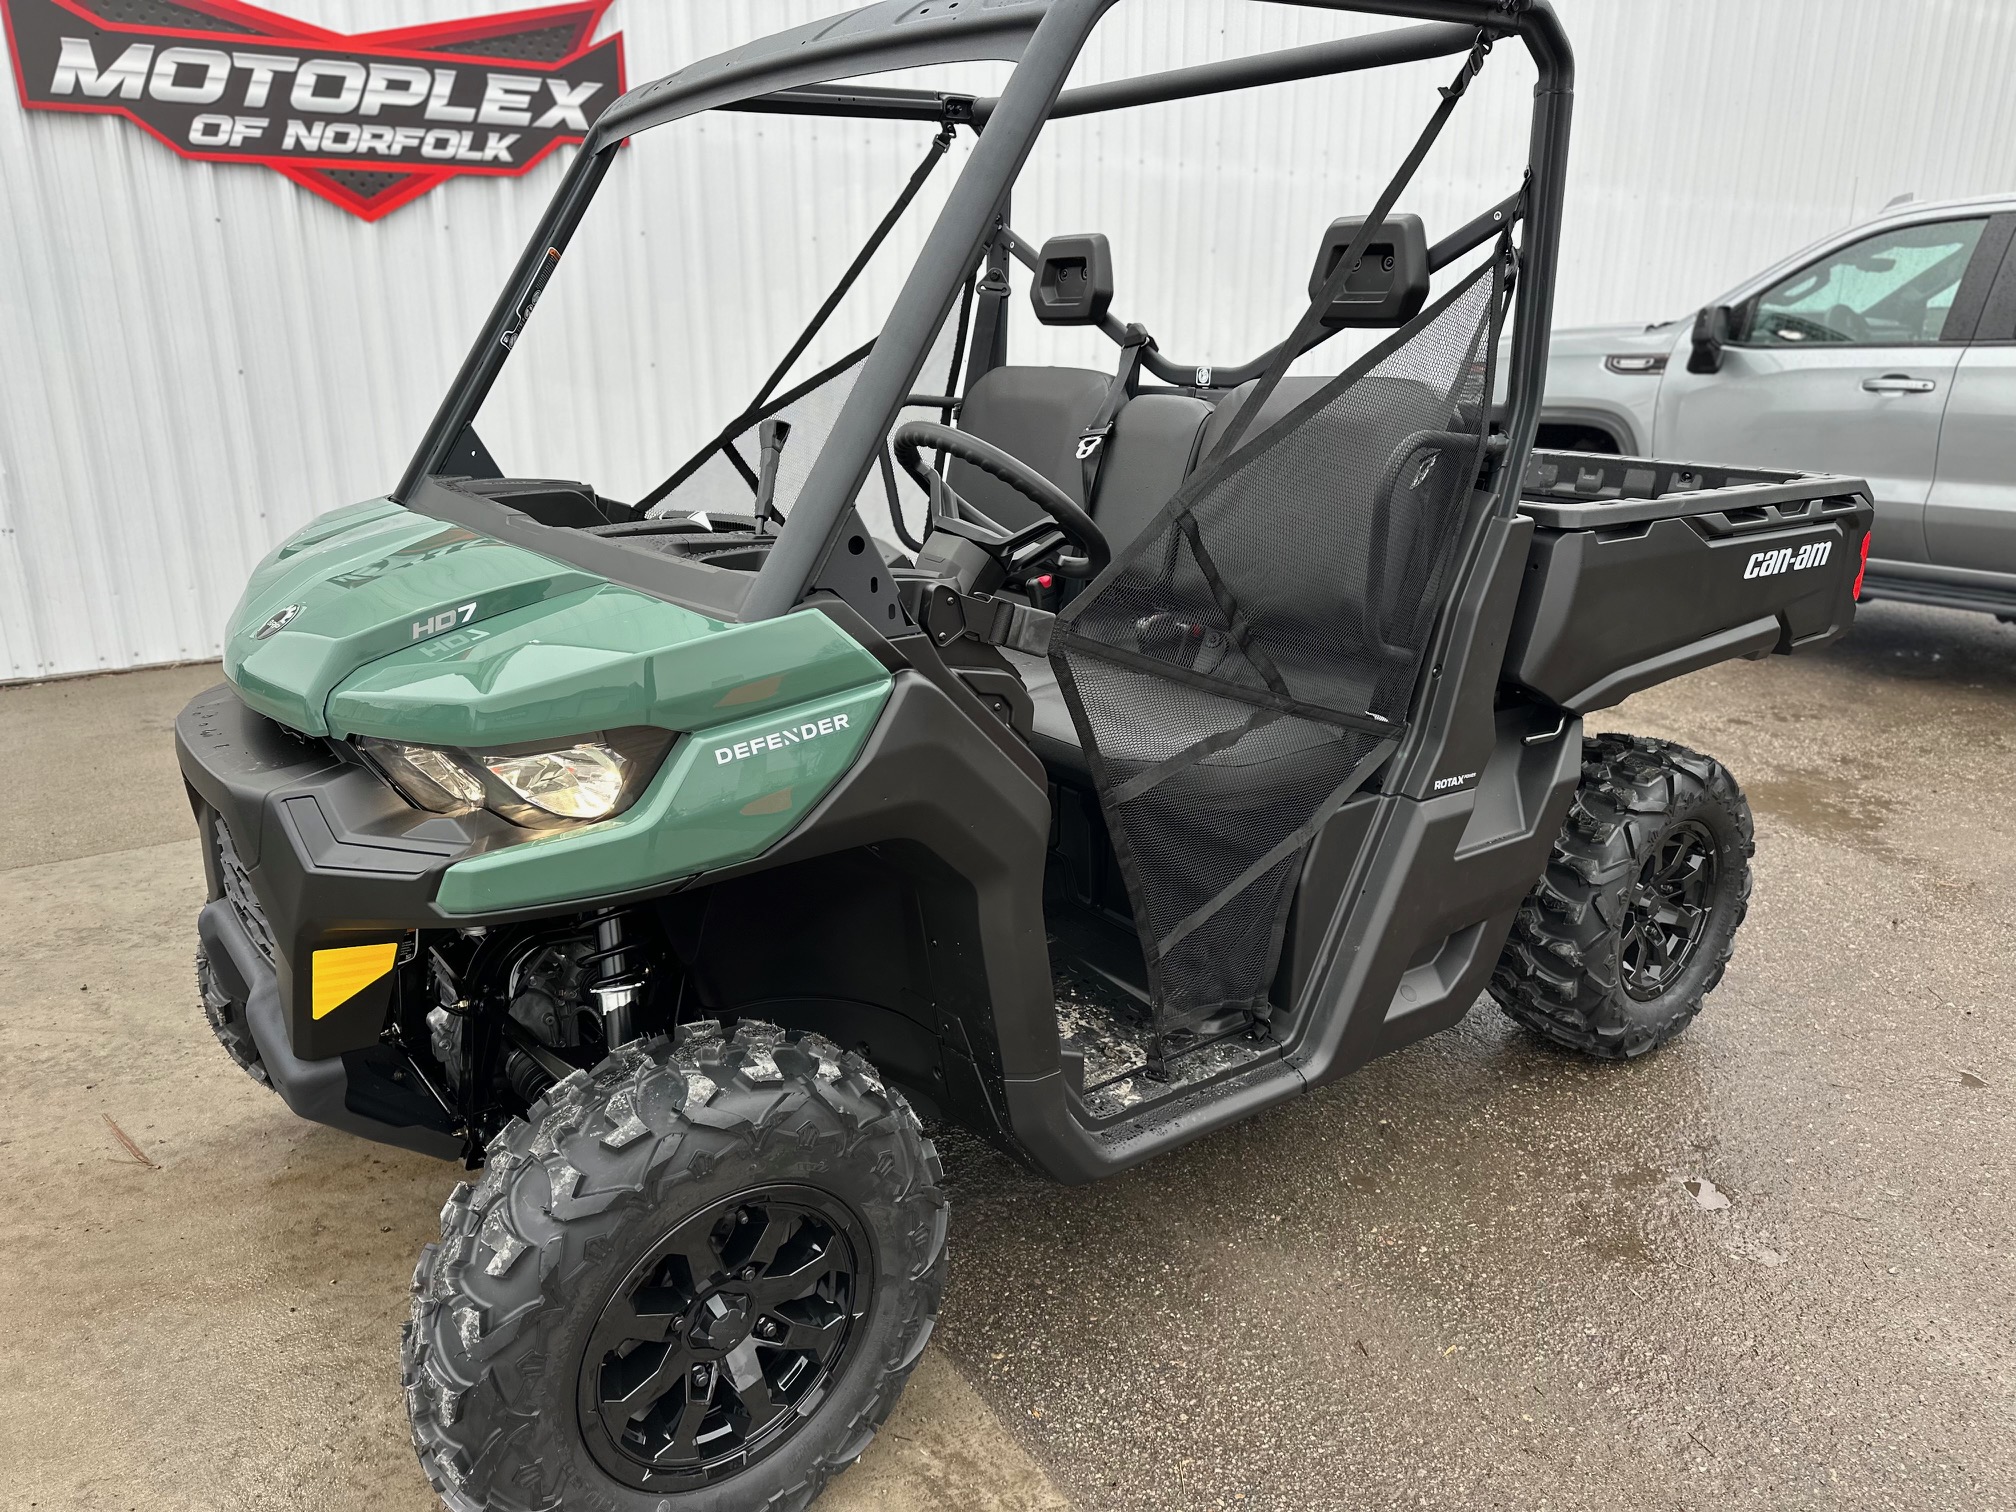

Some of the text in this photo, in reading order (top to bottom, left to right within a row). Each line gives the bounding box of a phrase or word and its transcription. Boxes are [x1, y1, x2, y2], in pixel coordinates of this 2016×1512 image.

[50, 36, 604, 131] MOTOPLEX
[188, 113, 522, 163] OF NORFOLK
[1743, 541, 1832, 580] can-am
[412, 601, 477, 640] HD7
[714, 713, 850, 765] DEFENDER
[1434, 775, 1464, 790] ROTAX
